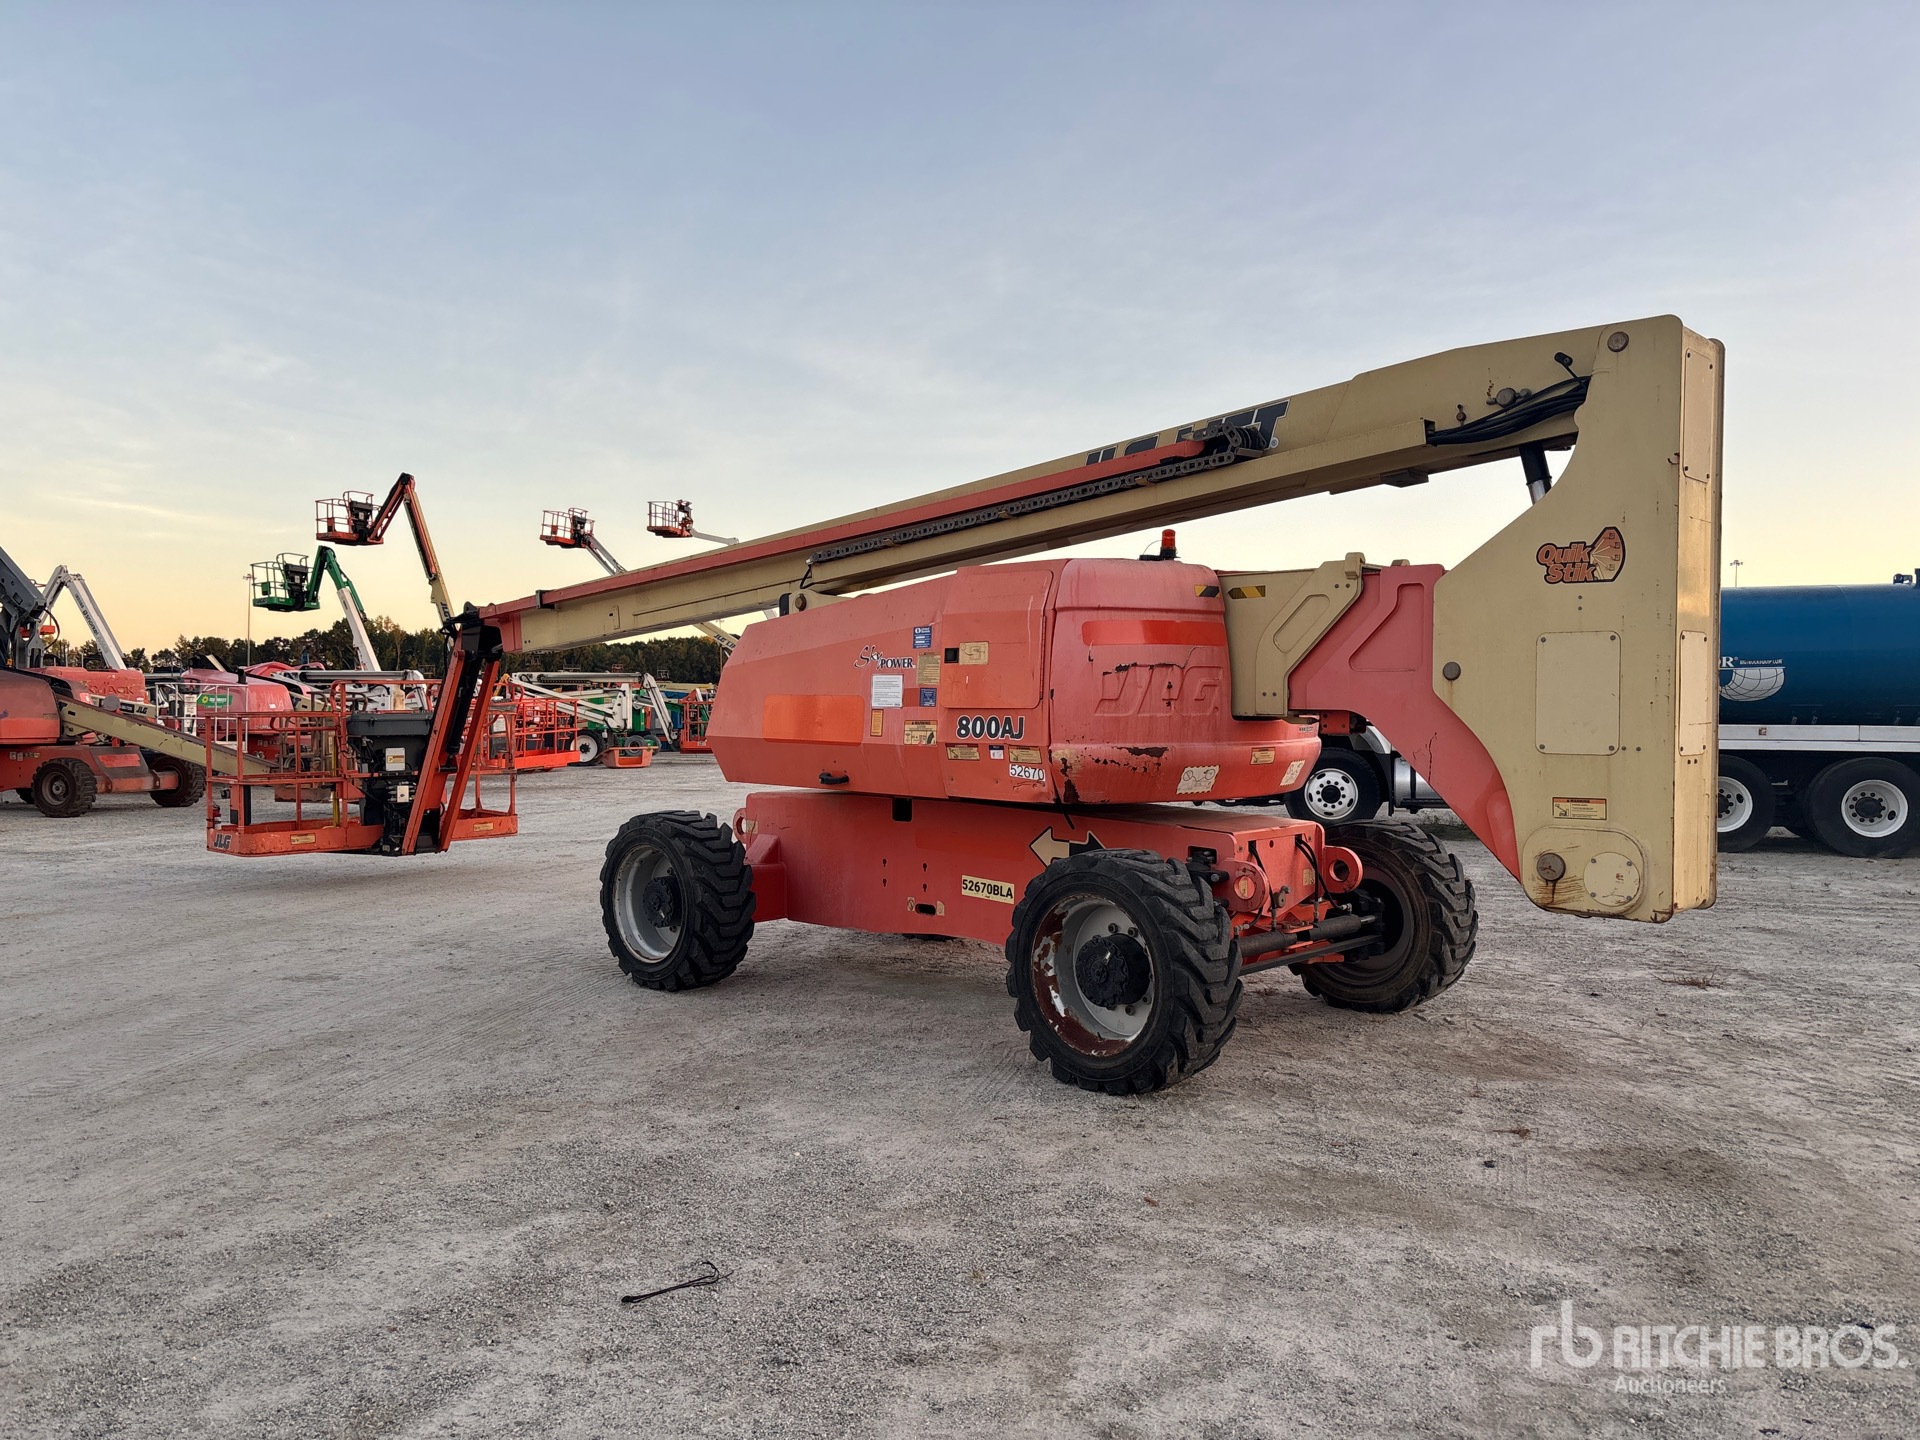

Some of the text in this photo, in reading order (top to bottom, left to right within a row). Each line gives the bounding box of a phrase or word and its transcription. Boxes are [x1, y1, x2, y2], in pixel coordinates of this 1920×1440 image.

[1538, 544, 1591, 566] Quik
[1546, 562, 1595, 582] Stik
[714, 634, 726, 643] JLG
[853, 645, 883, 670] Sky
[879, 657, 913, 669] POWER
[1094, 663, 1222, 717] JLG
[136, 706, 148, 714] JLG
[955, 715, 1025, 740] 800AJ
[1010, 764, 1045, 781] 52670
[213, 833, 232, 850] JLG
[962, 878, 1014, 899] 52670BLA
